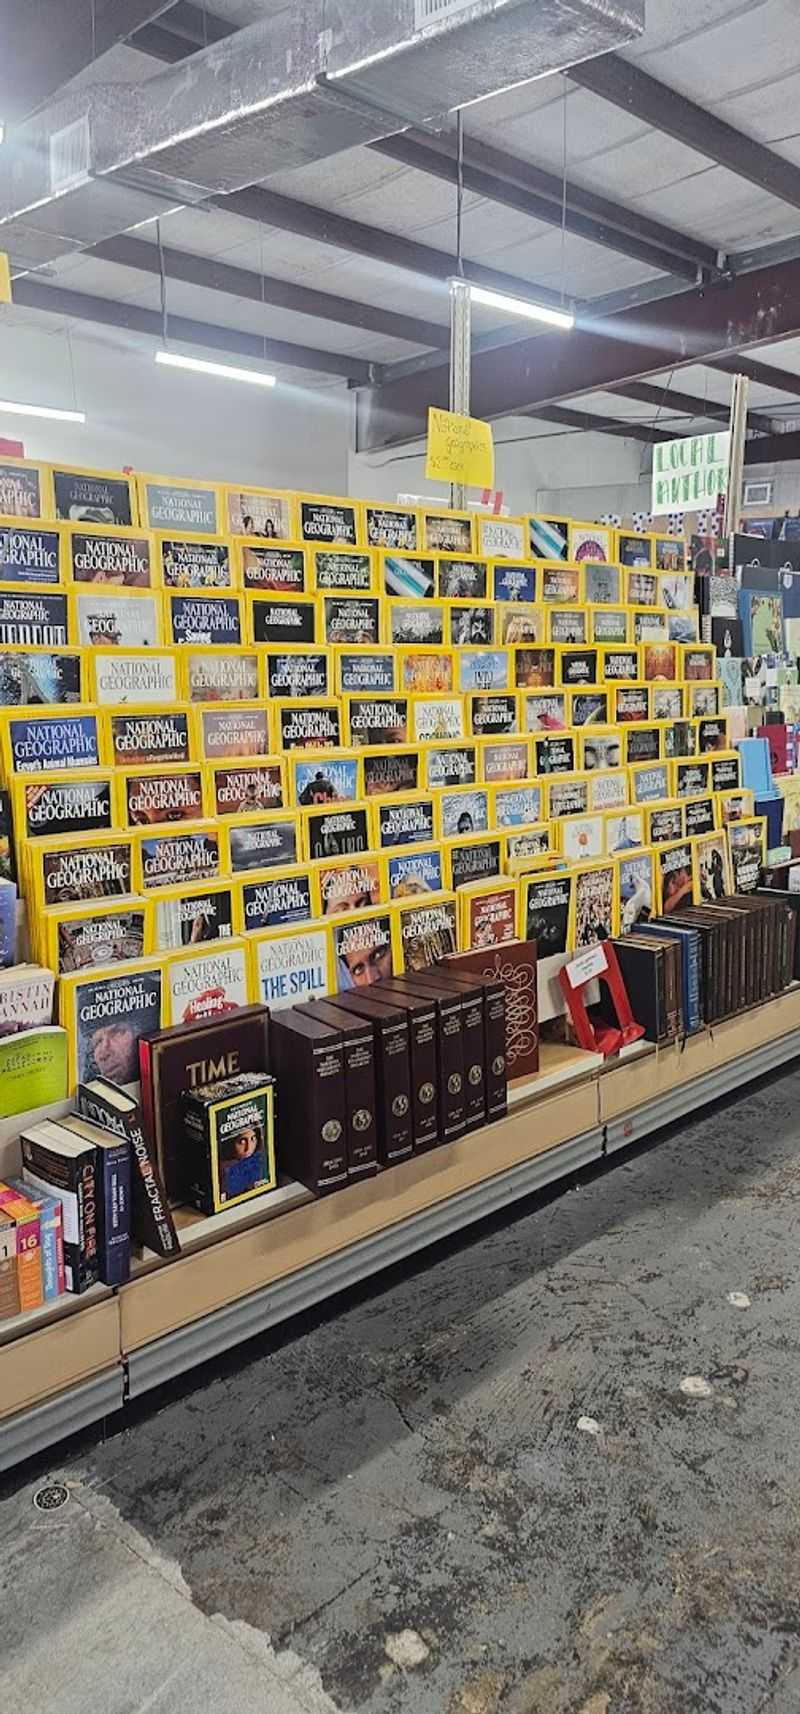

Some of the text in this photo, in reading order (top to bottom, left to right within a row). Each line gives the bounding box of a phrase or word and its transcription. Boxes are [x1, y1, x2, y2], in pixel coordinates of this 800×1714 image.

[656, 436, 727, 472] LOCAL
[656, 468, 728, 504] AUTHOR
[162, 495, 202, 508] NATIONAL
[152, 507, 213, 523] GEOGRAPHIC
[313, 513, 344, 524] NATIONAL
[304, 521, 353, 537] GEOGRAPHIC
[85, 540, 137, 558] NATIONAL
[74, 554, 148, 573] GEOGRAPHIC
[178, 552, 218, 566] NATIONAL
[257, 557, 292, 569] NATIONAL
[167, 562, 228, 578] GEOGRAPHIC
[247, 565, 301, 582] GEOGRAPHIC
[326, 563, 359, 574] NATIONAL
[319, 570, 368, 586] GEOGRAPHIC
[4, 600, 45, 611] NATIONAL
[183, 604, 229, 617] NATIONAL
[270, 608, 299, 617] NATIONAL
[338, 608, 368, 618] NATIONAL
[174, 615, 237, 631] GEOGRAPHIC
[266, 614, 302, 626] GEOGRAPHIC
[331, 618, 375, 630] GEOGRAPHIC
[111, 662, 161, 676] NATIONAL
[200, 661, 246, 674] NATIONAL
[281, 663, 316, 673] NATIONAL
[352, 664, 384, 673] NATIONAL
[100, 675, 171, 690] GEOGRAPHIC
[192, 673, 256, 687] GEOGRAPHIC
[272, 673, 324, 687] GEOGRAPHIC
[343, 673, 392, 685] GEOGRAPHIC
[359, 703, 397, 715] NATIONAL
[218, 720, 256, 731] NATIONAL
[291, 711, 329, 726] NATIONAL
[351, 714, 407, 728] GEOGRAPHIC
[27, 724, 85, 741] NATIONAL
[126, 720, 177, 735] NATIONAL
[283, 722, 338, 739] GEOGRAPHIC
[115, 732, 187, 751] GEOGRAPHIC
[208, 730, 266, 746] GEOGRAPHIC
[15, 736, 96, 758] GEOGRAPHIC
[16, 759, 42, 772] Egypt's
[43, 757, 66, 770] Animal
[373, 759, 410, 772] NATIONAL
[226, 770, 272, 786] NATIONAL
[366, 770, 416, 787] GEOGRAPHIC
[41, 787, 98, 805] NATIONAL
[139, 779, 190, 797] NATIONAL
[129, 791, 201, 811] GEOGRAPHIC
[29, 800, 109, 822] GEOGRAPHIC
[389, 806, 424, 820] NATIONAL
[381, 815, 432, 834] GEOGRAPHIC
[249, 830, 278, 840] NATIONAL
[155, 839, 206, 857] NATIONAL
[244, 836, 283, 851] GEOGRAPHIC
[60, 851, 116, 869] NATIONAL
[145, 852, 218, 874] GEOGRAPHIC
[461, 849, 491, 861] NATIONAL
[398, 858, 433, 871] NATIONAL
[453, 857, 497, 875] GEOGRAPHIC
[47, 863, 129, 888] GEOGRAPHIC
[330, 869, 368, 885] NATIONAL
[255, 883, 299, 900] NATIONAL
[323, 879, 379, 900] GEOGRAPHIC
[537, 887, 563, 897] NATIONAL
[246, 892, 309, 917] GEOGRAPHIC
[529, 894, 569, 910] GEOGRAPHIC
[410, 906, 446, 922] NATIONAL
[82, 920, 123, 936] NATIONAL
[342, 922, 381, 938] NATIONAL
[403, 916, 455, 938] GEOGRAPHIC
[76, 927, 127, 945] GEOGRAPHIC
[337, 931, 390, 955] GEOGRAPHIC
[271, 938, 314, 954] NATIONAL
[184, 957, 232, 980] NATIONAL
[261, 949, 323, 973] GEOGRAPHIC
[173, 967, 242, 997] GEOGRAPHIC
[261, 967, 325, 1000] THE SPILL
[95, 983, 145, 1003] NATIONAL
[80, 992, 157, 1022] GEOGRAPHIC
[190, 993, 224, 1016] Healing
[186, 1050, 240, 1087] TIME
[227, 1105, 257, 1122] NATIONAL
[221, 1110, 264, 1134] GEOGRAPHIC
[131, 1128, 149, 1164] NOISE
[141, 1160, 166, 1222] FRACTAL
[83, 1164, 97, 1260] CITY ON FIRE
[20, 1235, 37, 1251] 16
